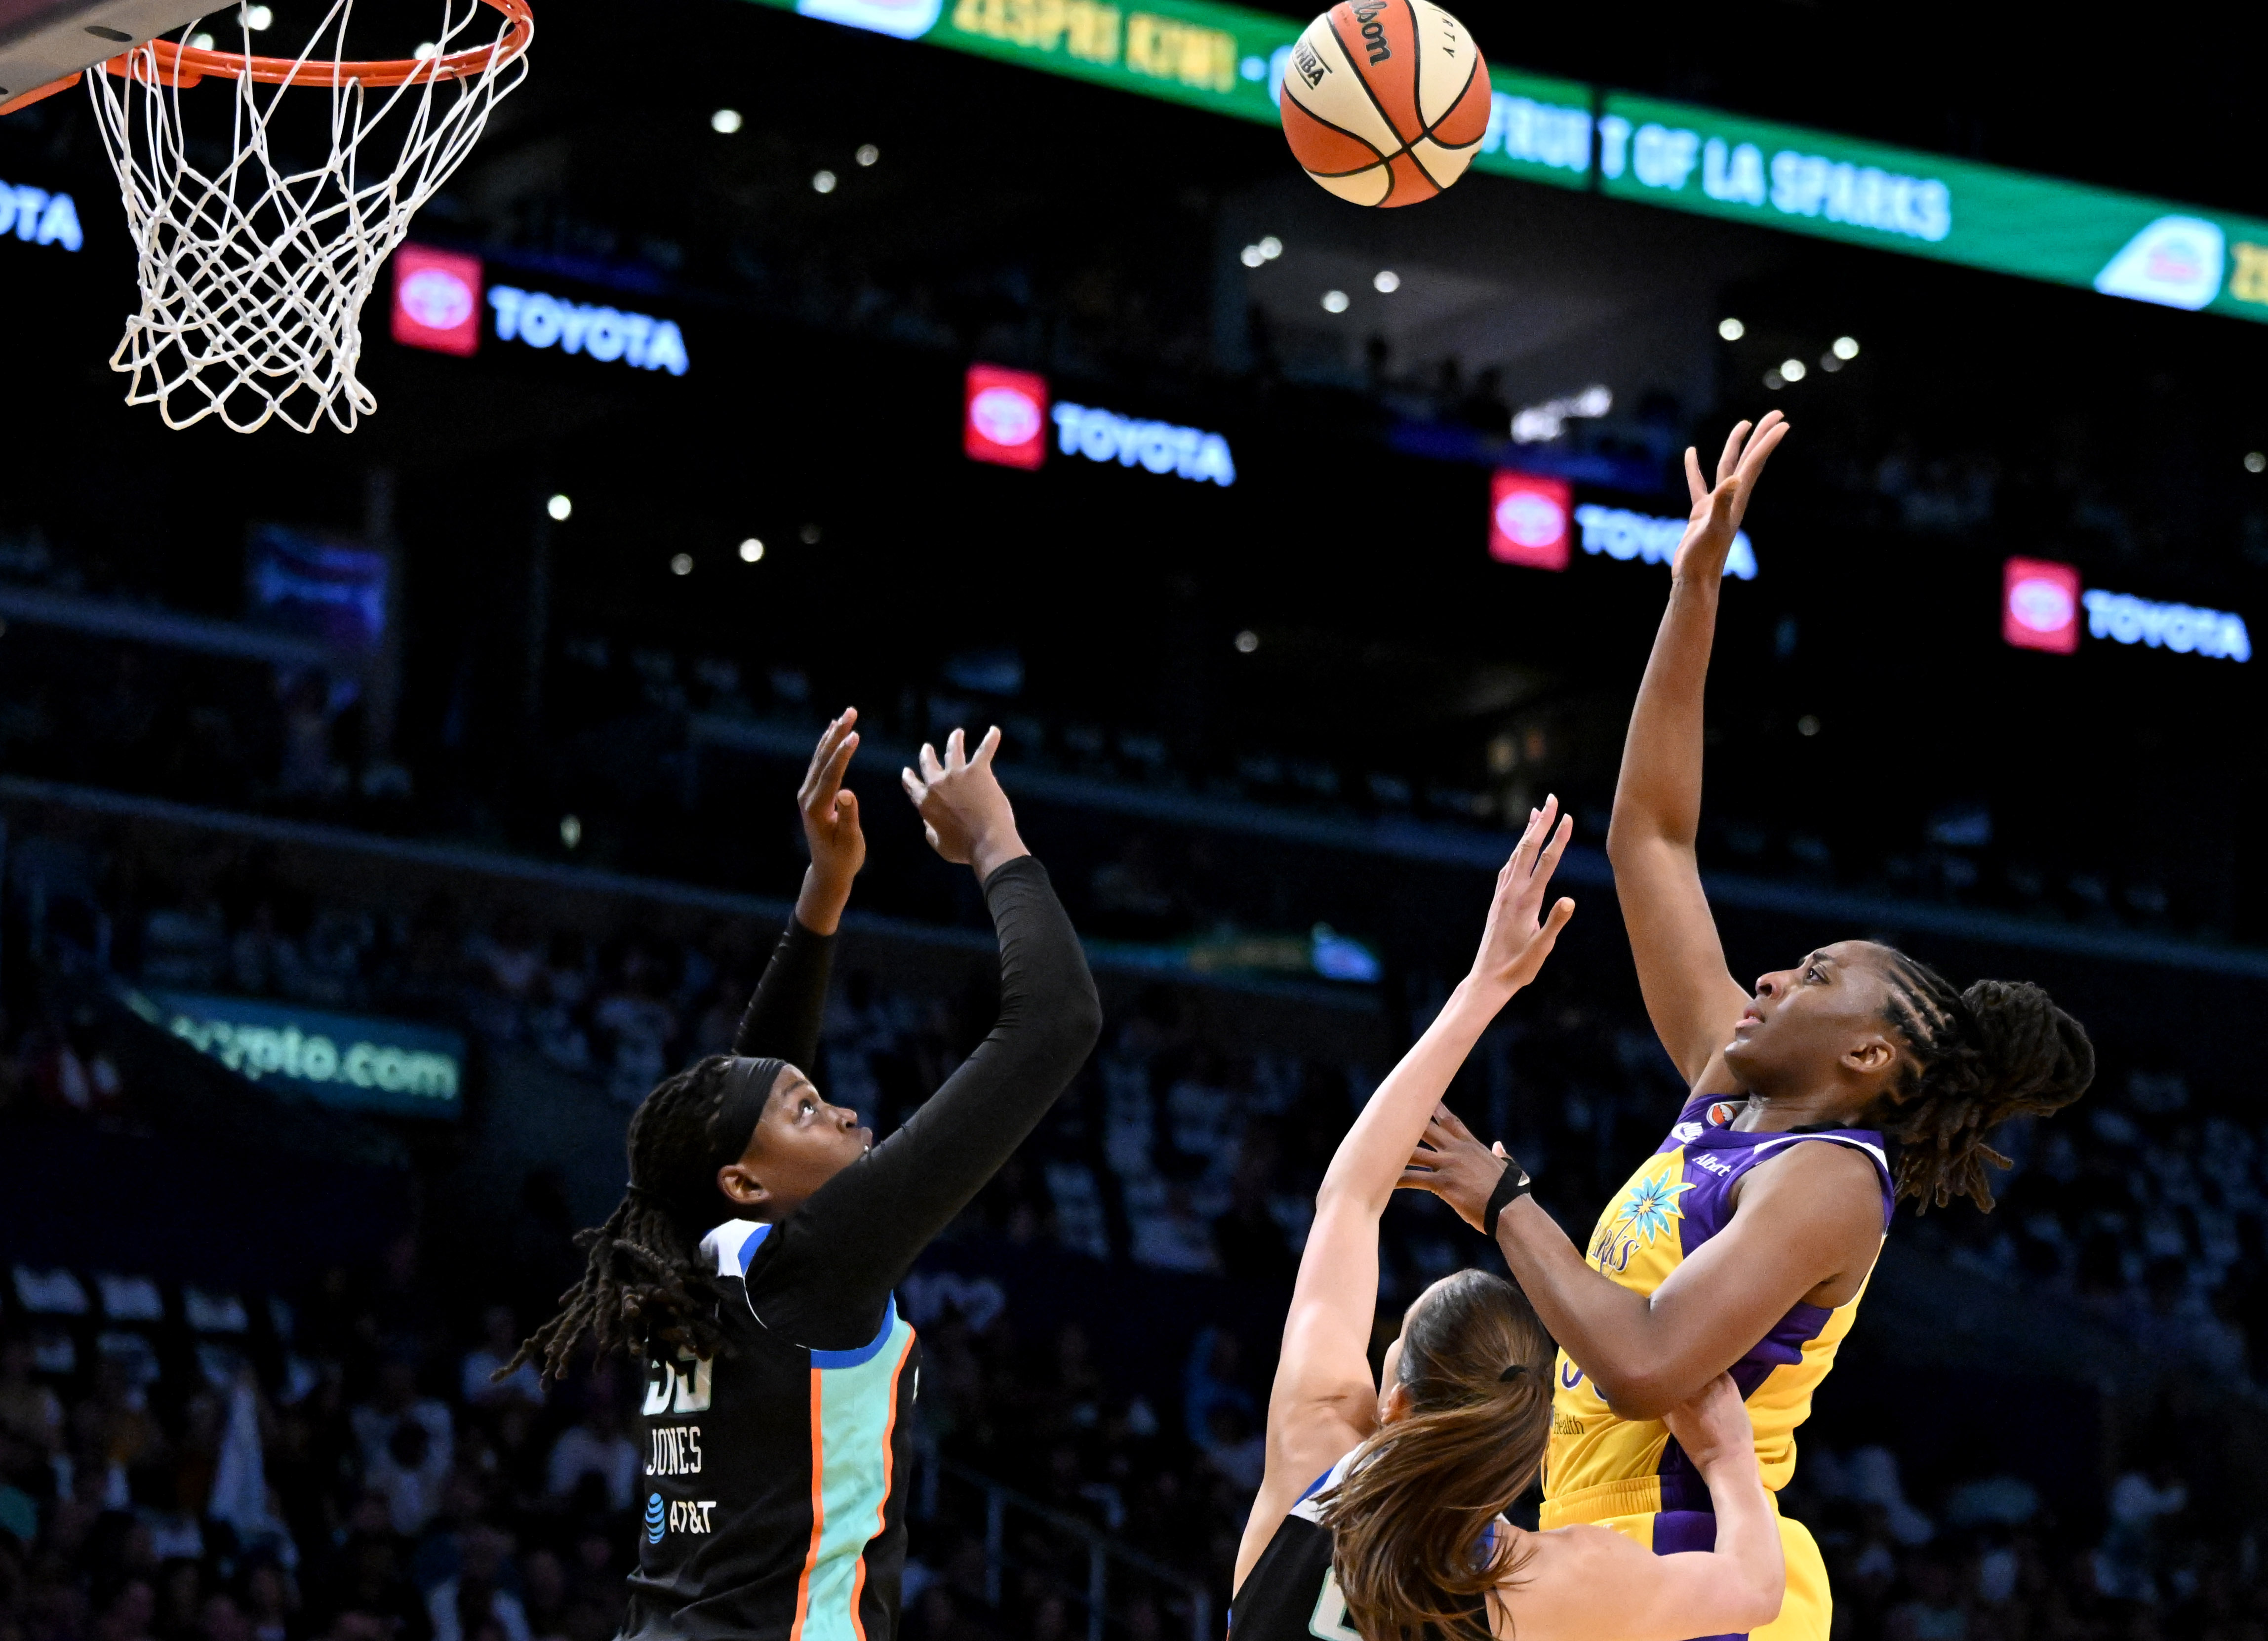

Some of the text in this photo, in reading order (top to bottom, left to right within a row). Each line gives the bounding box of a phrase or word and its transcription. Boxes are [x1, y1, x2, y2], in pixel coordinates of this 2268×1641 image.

[1352, 0, 1392, 67] lson
[1632, 123, 1701, 191] OF
[1702, 137, 1766, 206] LA
[1770, 150, 1952, 242] SPARKS
[487, 285, 689, 376] TOYOTA
[1051, 401, 1235, 487] TOYOTA
[1574, 504, 1758, 580] TOYA
[2082, 589, 2251, 663] TOYOTA
[646, 1426, 702, 1476] JONES
[1554, 1413, 1585, 1435] Health
[670, 1500, 716, 1534] AT&T
